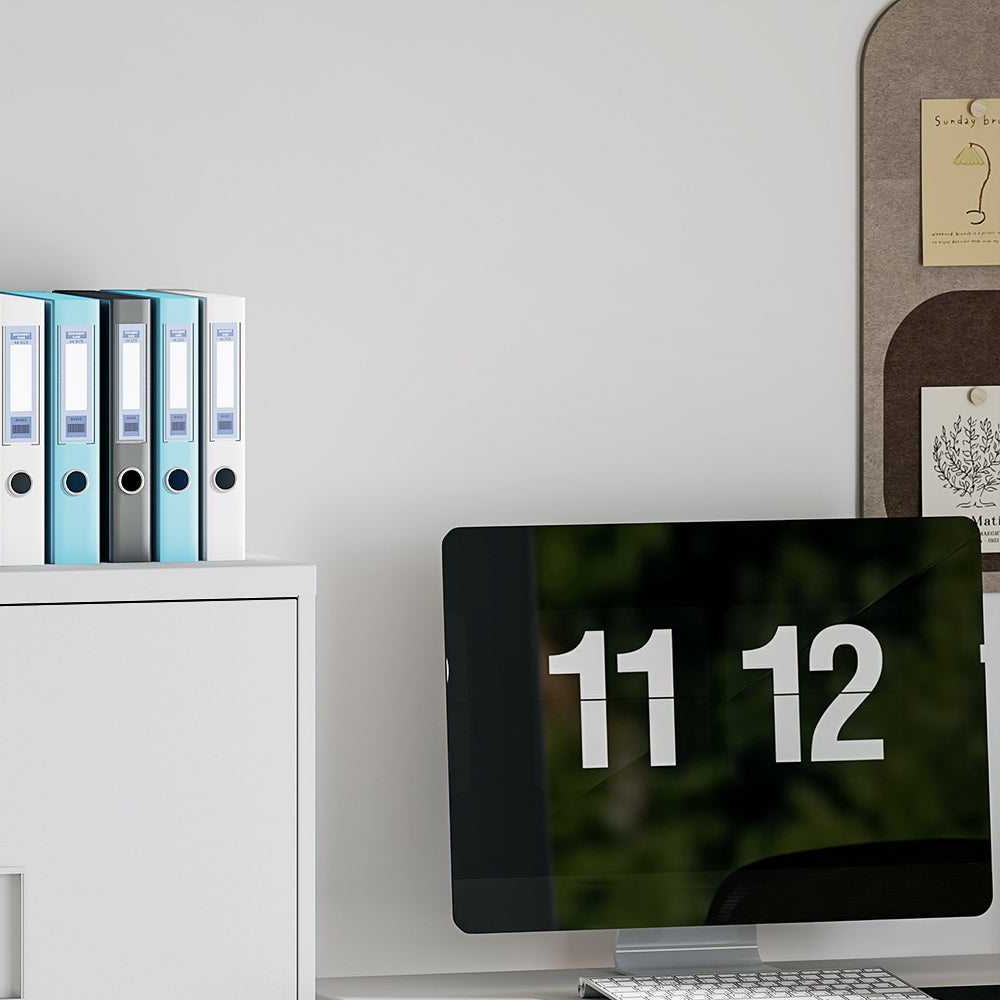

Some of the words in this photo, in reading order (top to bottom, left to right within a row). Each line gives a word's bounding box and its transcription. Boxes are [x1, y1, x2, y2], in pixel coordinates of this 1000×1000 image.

[934, 114, 976, 129] Sunday
[548, 628, 676, 770] 11
[741, 623, 885, 763] 12
